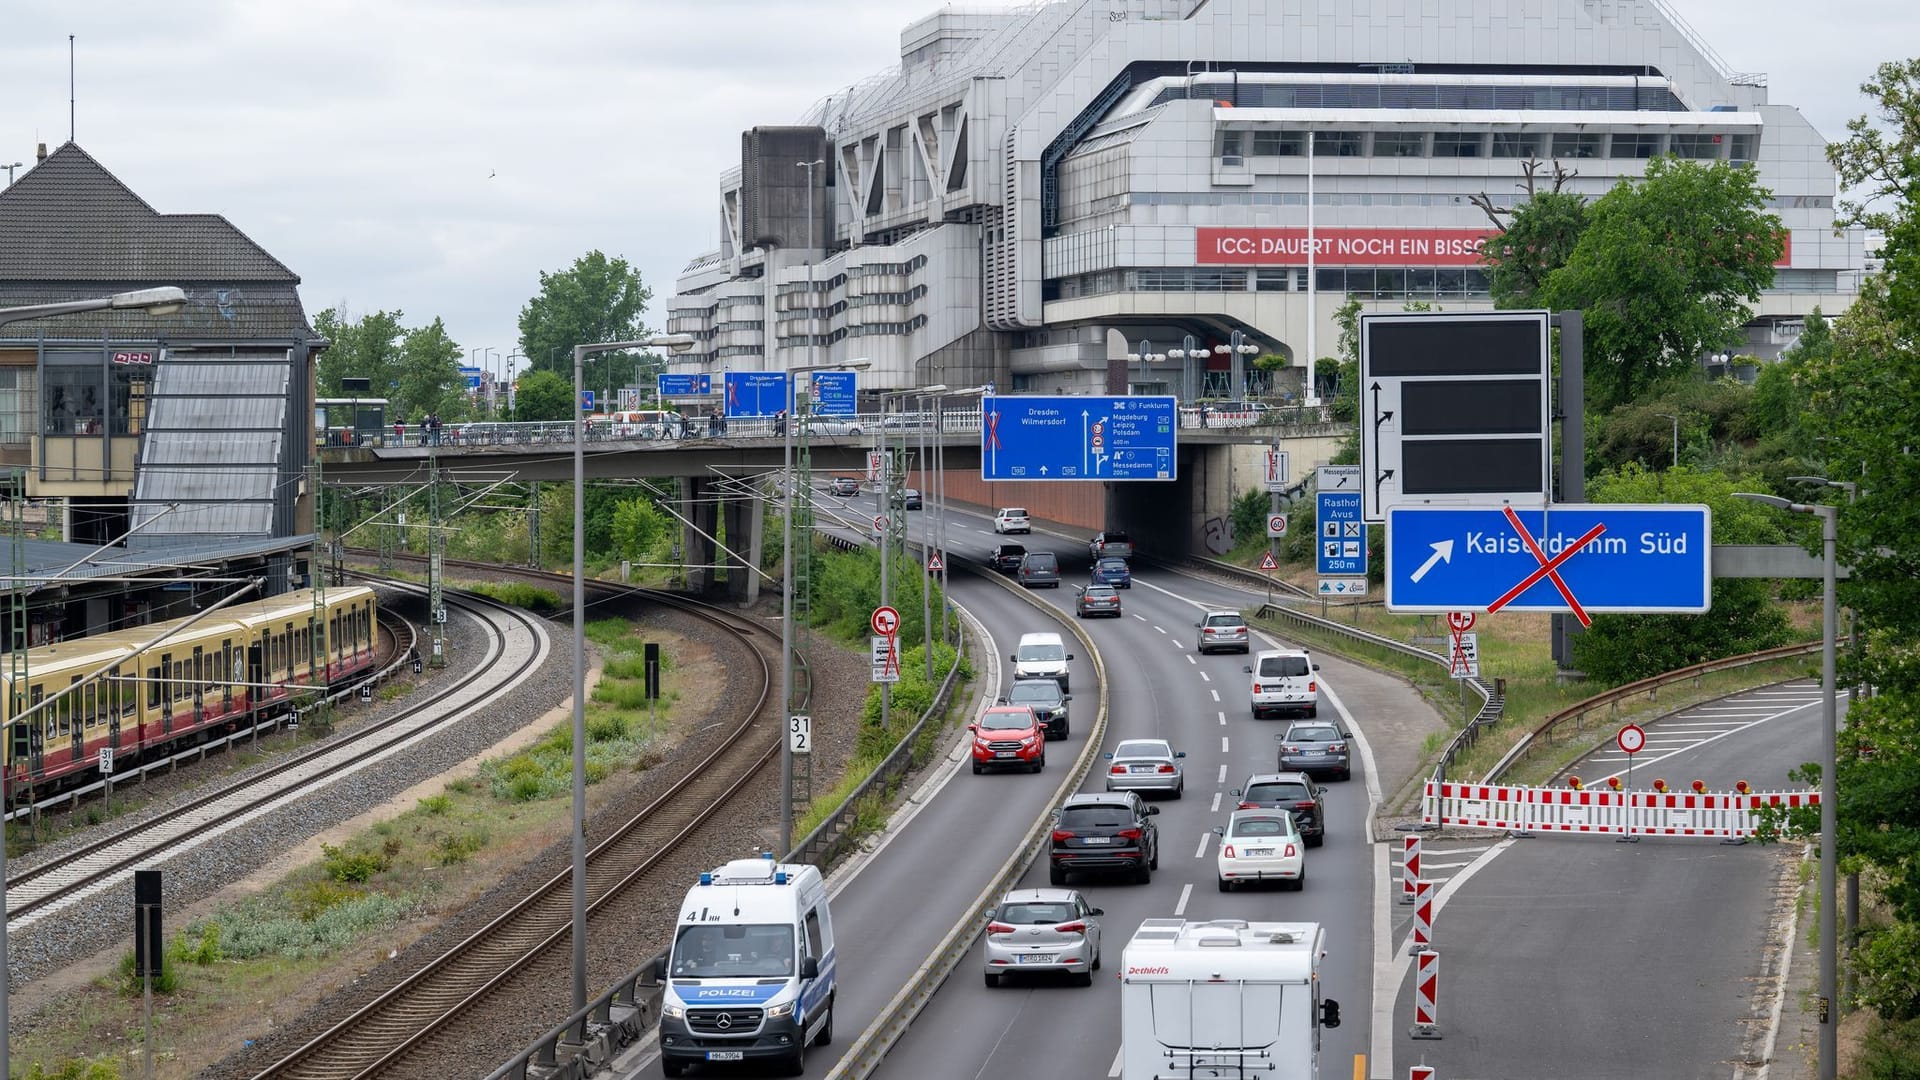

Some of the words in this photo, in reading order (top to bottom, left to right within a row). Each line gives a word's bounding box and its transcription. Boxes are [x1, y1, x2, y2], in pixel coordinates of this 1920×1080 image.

[1216, 238, 1256, 255] ICC:
[1261, 238, 1333, 255] DAUERT
[1338, 238, 1395, 255] NOCH
[1400, 239, 1429, 255] EIN
[1028, 408, 1059, 416] Dresden
[1021, 417, 1067, 425] Wilmersdorf
[1112, 414, 1149, 422] Magdeburg
[1112, 422, 1136, 430] Leipzig
[1324, 498, 1360, 507] Rasthof
[1330, 510, 1354, 518] Avus
[1273, 520, 1281, 528] 60
[1640, 532, 1687, 554] Süd
[1328, 560, 1345, 569] 250
[1346, 561, 1356, 569] m
[414, 663, 421, 672] H
[362, 686, 370, 696] H
[289, 712, 297, 723] H
[791, 718, 809, 733] 31
[796, 734, 805, 748] 2
[102, 750, 111, 759] 31
[103, 760, 109, 769] 2
[1128, 967, 1169, 975] Dethleffs
[698, 990, 755, 998] POLIZEI
